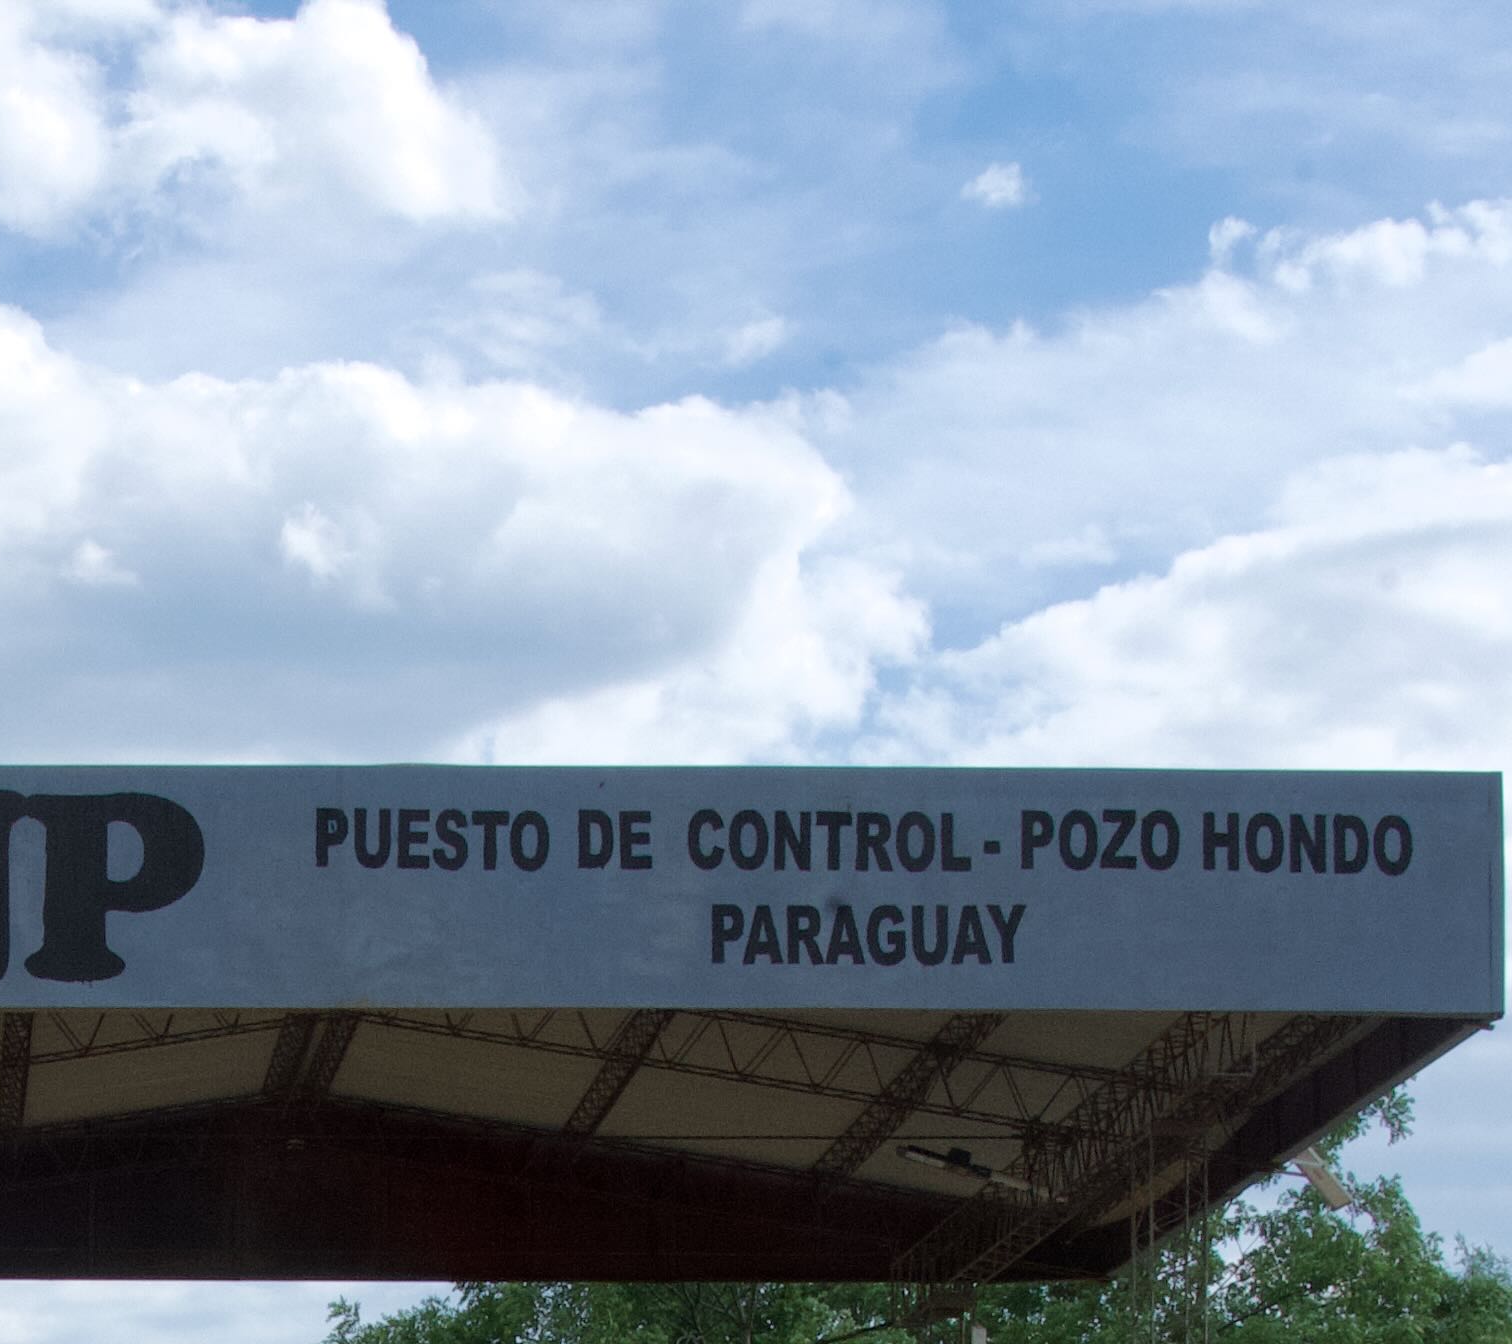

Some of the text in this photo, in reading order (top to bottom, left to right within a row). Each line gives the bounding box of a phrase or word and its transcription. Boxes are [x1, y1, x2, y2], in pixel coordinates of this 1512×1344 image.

[315, 807, 550, 872] PUESTO
[577, 809, 654, 870] DE
[687, 808, 972, 873] CONTROL
[1020, 809, 1179, 872] POZO
[1202, 811, 1414, 877] HONDO
[711, 903, 1026, 966] PARAGUAY
